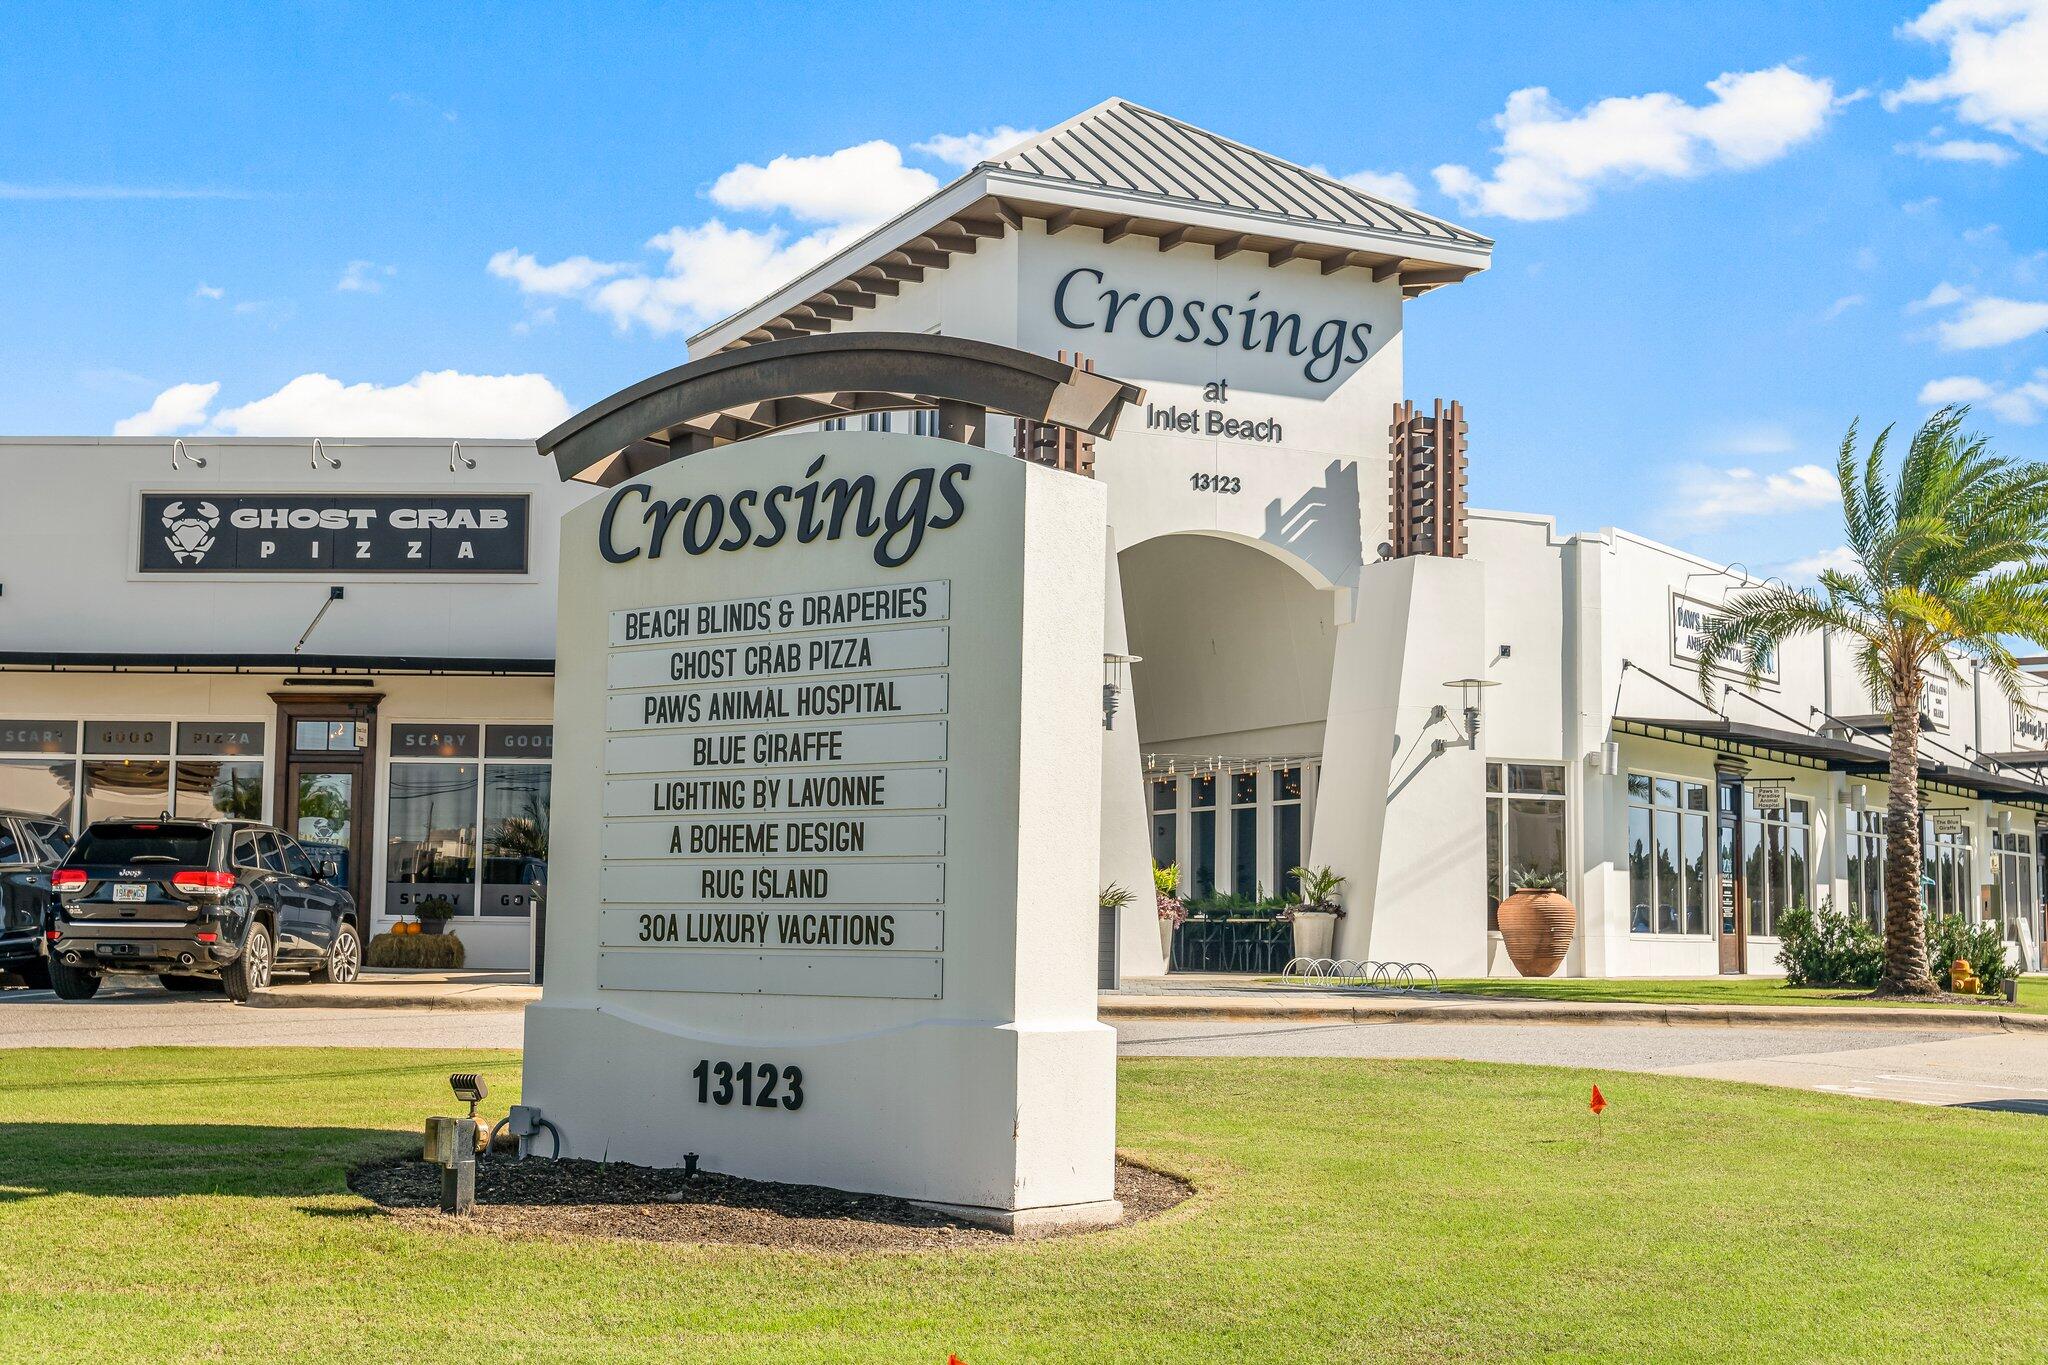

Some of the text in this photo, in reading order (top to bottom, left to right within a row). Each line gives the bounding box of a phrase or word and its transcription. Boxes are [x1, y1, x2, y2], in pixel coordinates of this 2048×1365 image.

[1053, 267, 1373, 383] Crossings
[1203, 378, 1228, 404] at
[1147, 403, 1282, 443] Inlet Beach
[1190, 472, 1241, 494] 13123
[230, 508, 509, 530] GHOST CRAB
[599, 454, 971, 568] Crossings
[261, 541, 475, 559] PIZZA
[626, 586, 928, 640] BEACH BLINDS & DRAPERIES
[1677, 606, 1700, 632] PAWS
[670, 637, 872, 681] GHOST CRAB PIZZA
[644, 681, 901, 724] PAWS ANIMAL HOSPITAL
[193, 732, 250, 745] PIZZA
[406, 734, 467, 747] SCARY
[694, 731, 842, 766] BLUE GIRAFFE
[654, 775, 885, 811] LIGHTING BY LAVONNE
[669, 821, 865, 854] A BOHEME DESIGN
[119, 868, 141, 878] Jeep
[702, 869, 829, 899] RUG ISLAND
[639, 914, 895, 946] 30A LUXURY VACATIONS
[692, 1059, 805, 1111] 13123
